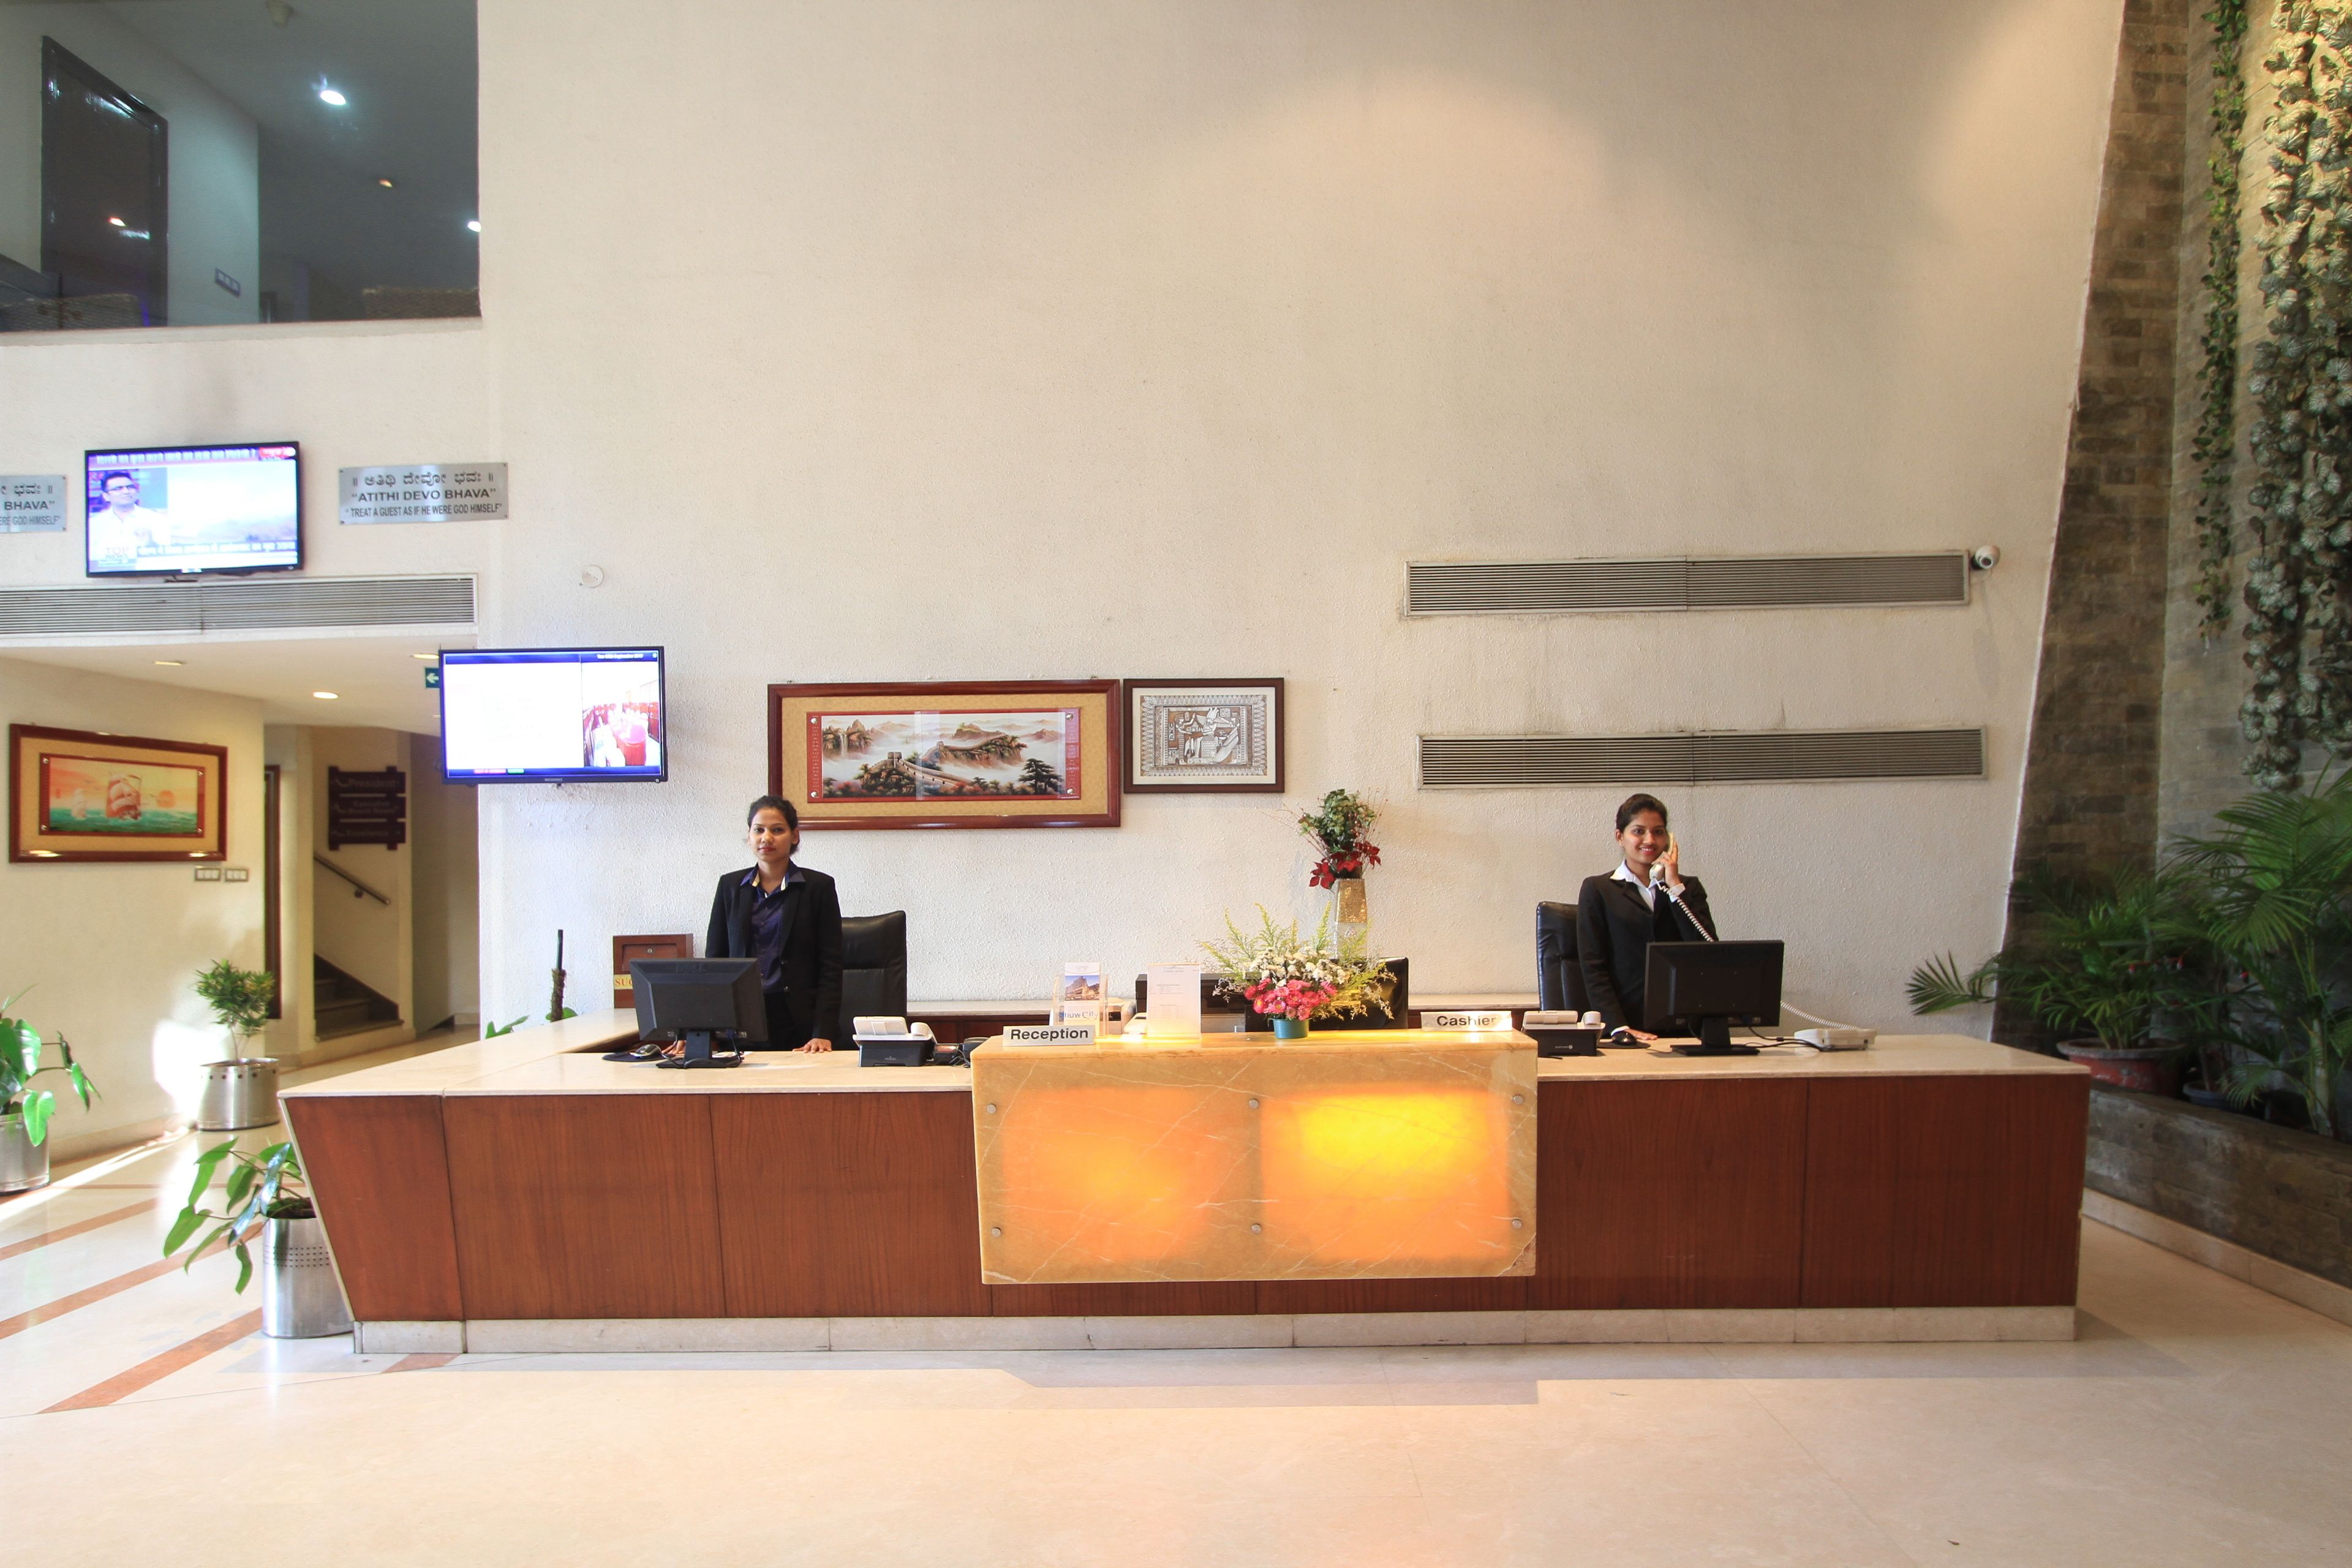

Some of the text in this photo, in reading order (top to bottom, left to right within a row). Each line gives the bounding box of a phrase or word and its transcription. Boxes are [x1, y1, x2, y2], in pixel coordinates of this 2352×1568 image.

[404, 489, 440, 500] DEVO
[374, 508, 378, 516] A
[380, 506, 402, 516] GUEST
[403, 506, 413, 515] AS
[414, 506, 420, 515] IF
[421, 505, 430, 514] HE
[432, 504, 452, 514] WERE
[453, 504, 469, 514] GOD
[13, 516, 28, 526] GOD
[1436, 1016, 1497, 1027] Cashier
[1011, 1028, 1088, 1041] Reception
